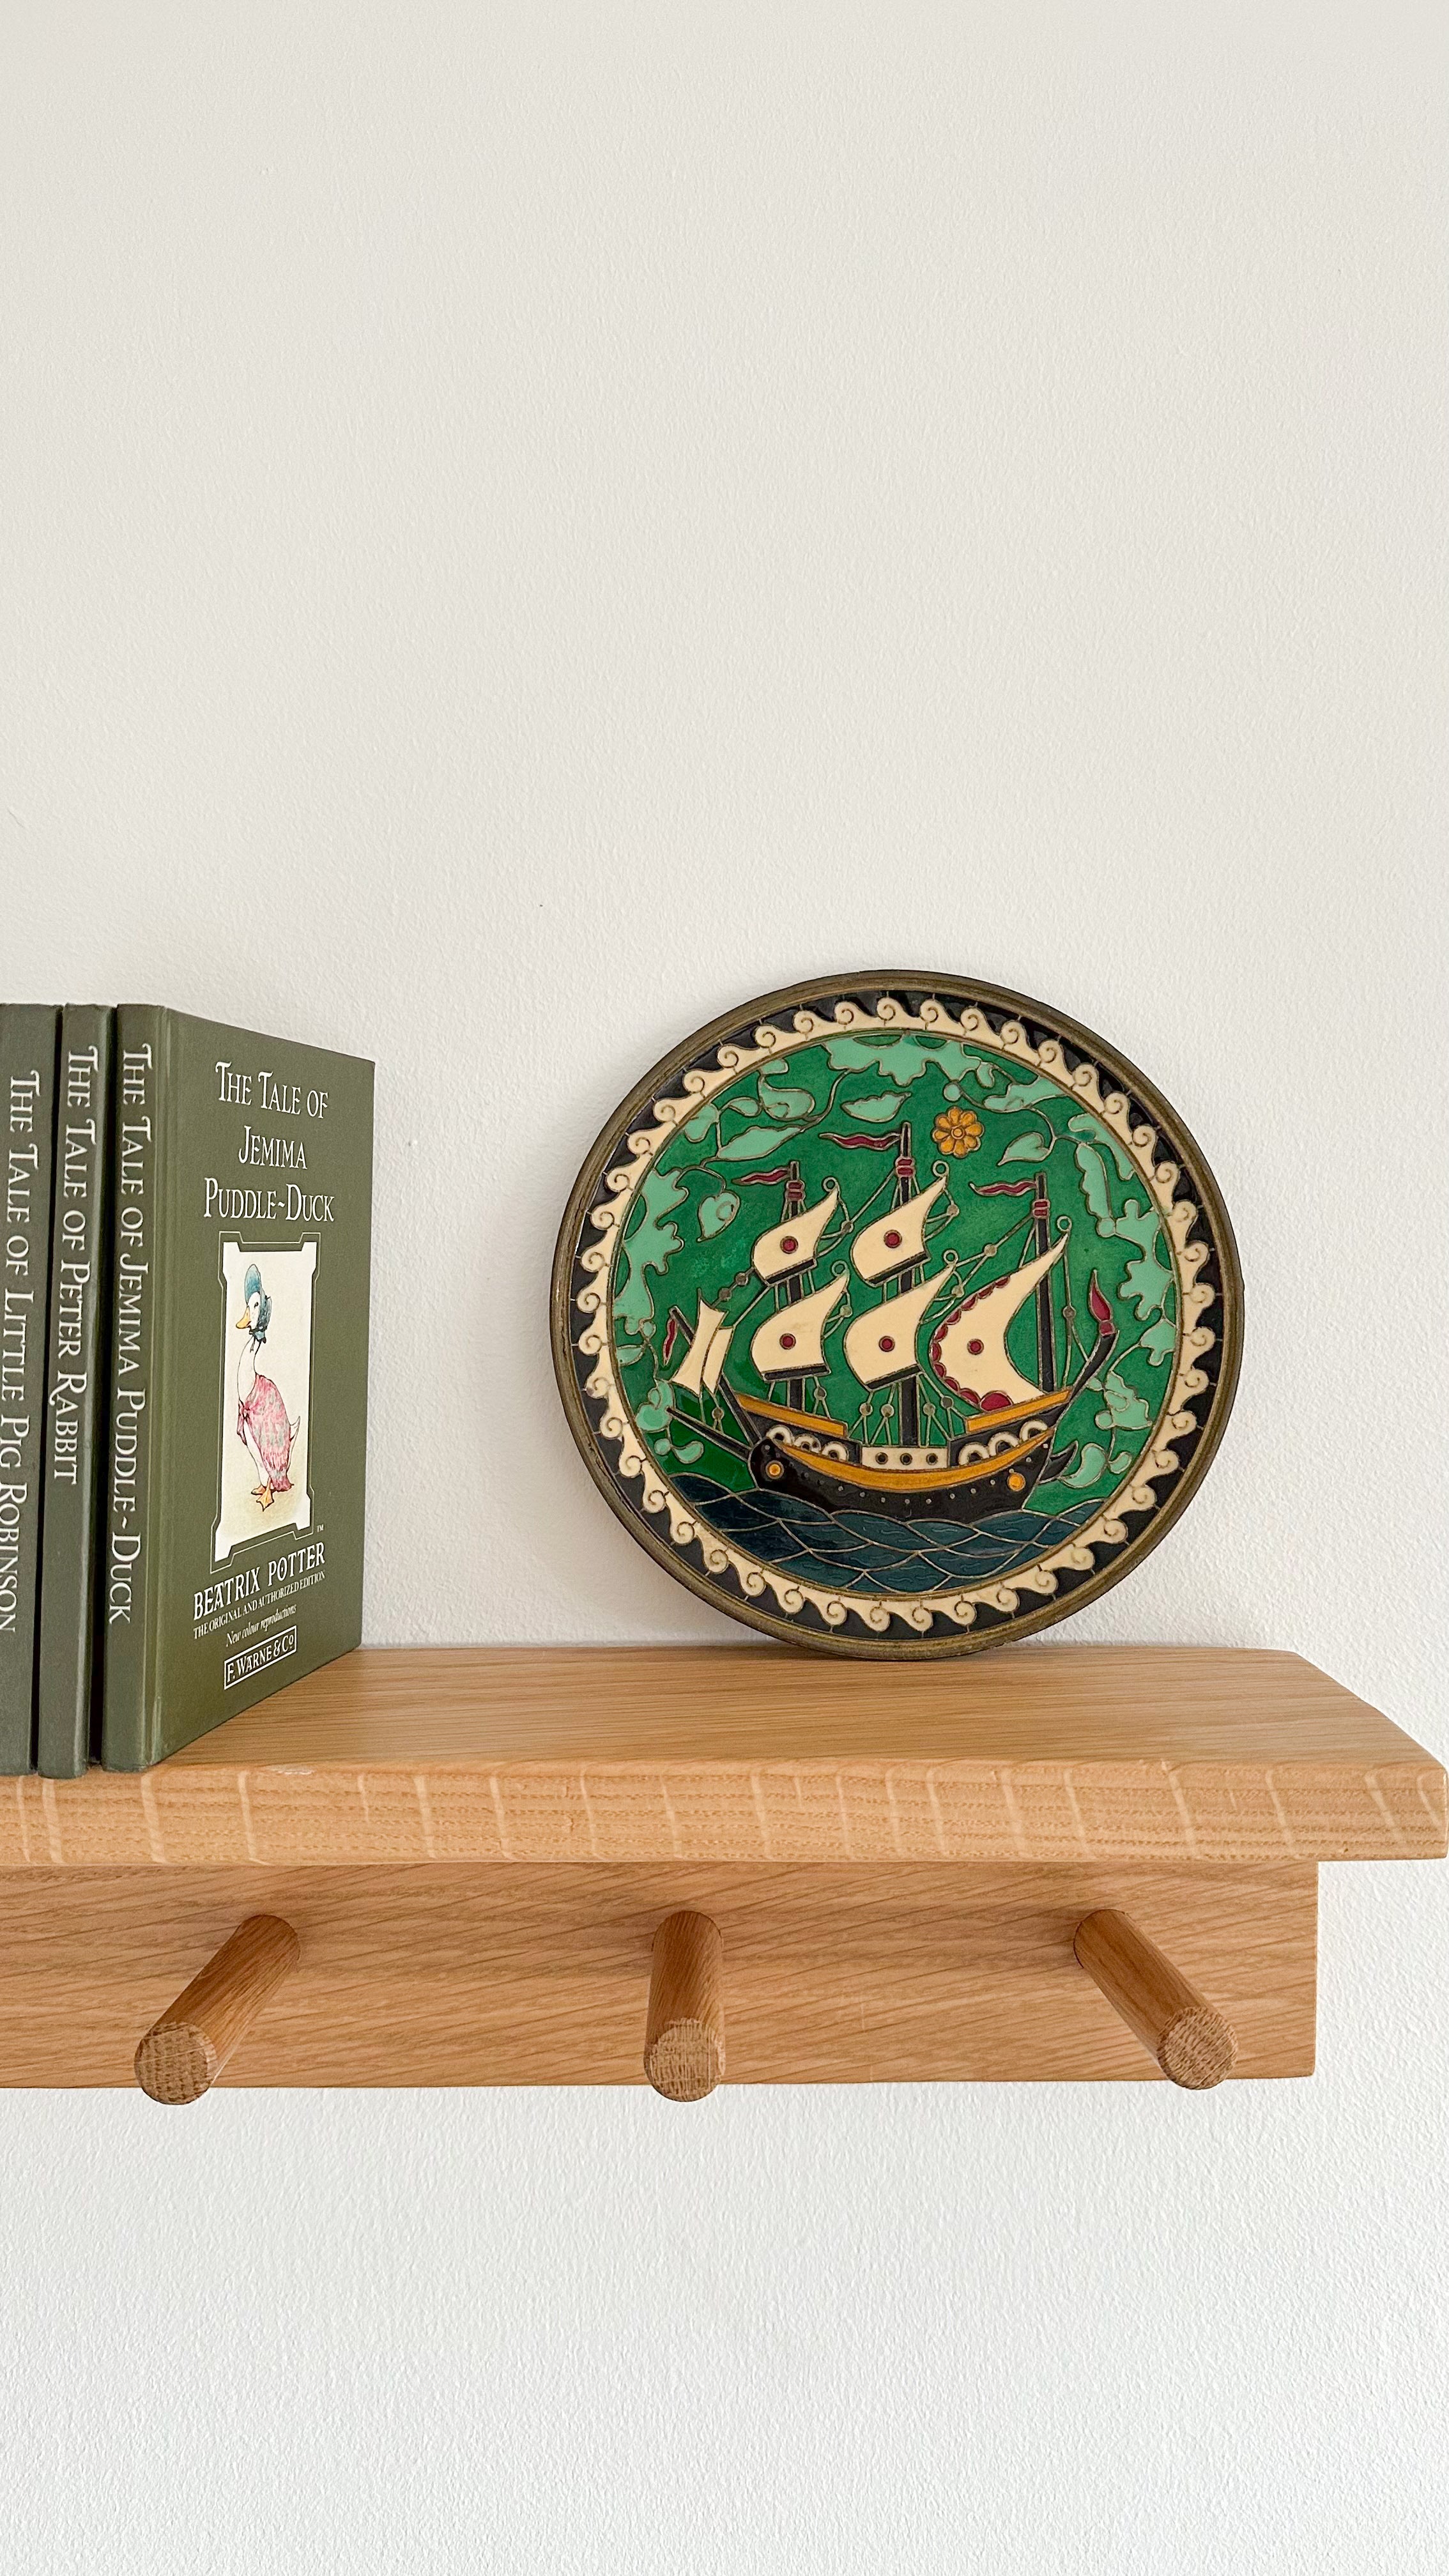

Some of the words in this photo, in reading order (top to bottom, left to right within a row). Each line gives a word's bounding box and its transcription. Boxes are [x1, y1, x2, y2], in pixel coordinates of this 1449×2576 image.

[10, 1070, 40, 1132] THE
[67, 1045, 99, 1107] THE
[123, 1043, 153, 1105] THE
[215, 1061, 252, 1105] THE
[258, 1071, 301, 1115] TALE
[307, 1090, 328, 1119] OF
[63, 1118, 96, 1198] TALE
[121, 1116, 151, 1195] TALE
[238, 1125, 307, 1169] JEMIMA
[7, 1143, 38, 1223] TALE
[6, 1235, 29, 1275] OF
[62, 1210, 86, 1250] OF
[120, 1206, 144, 1247] OF
[57, 1261, 90, 1358] PETER
[118, 1254, 149, 1376] JEMIMA
[1, 1289, 34, 1401] LITTLE
[0, 1415, 29, 1469] PIG
[49, 1372, 88, 1485] RABBIT
[0, 1482, 27, 1632] ROBINSON
[194, 1567, 261, 1620] BEATRIX
[268, 1542, 325, 1586] POTTER
[193, 1623, 209, 1639] THE
[209, 1607, 241, 1631] ORIGINAL
[243, 1599, 257, 1616] AND
[257, 1581, 300, 1609] AUTHORIZED
[299, 1570, 325, 1590] EDITION
[226, 1631, 241, 1647] New
[241, 1621, 259, 1639] colour
[260, 1604, 296, 1631] reproductions
[236, 1644, 272, 1676] WARNE
